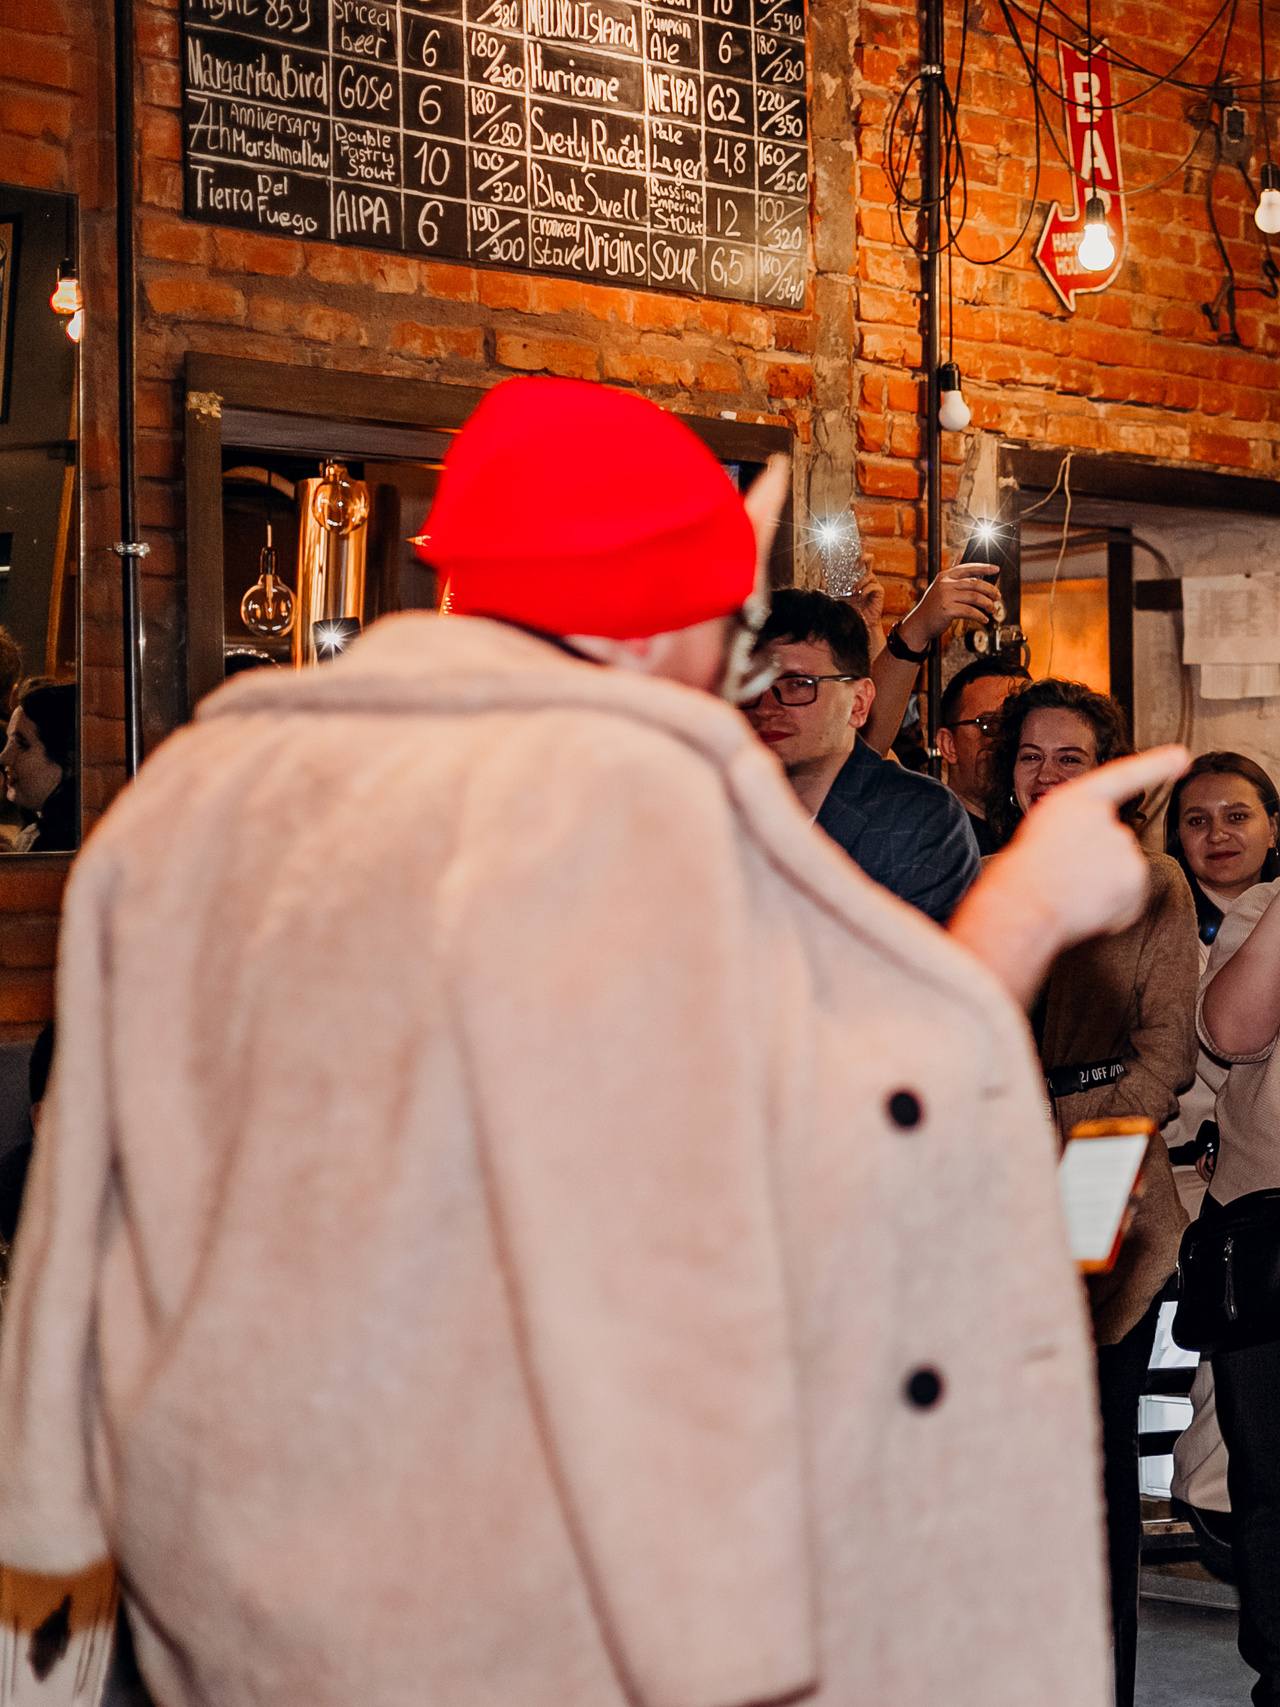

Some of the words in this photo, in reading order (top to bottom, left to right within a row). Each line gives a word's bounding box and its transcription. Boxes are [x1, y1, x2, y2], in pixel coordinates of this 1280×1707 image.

[341, 27, 387, 59] beer
[645, 9, 692, 39] Pumpkin
[422, 29, 441, 68] 6
[650, 32, 681, 64] Ale
[718, 31, 733, 64] 6
[187, 36, 286, 101] Margarita
[281, 54, 328, 105] Bird
[418, 84, 442, 125] 6
[648, 70, 698, 117] NEIPA
[187, 95, 231, 153] 7th
[334, 122, 391, 148] Double
[652, 121, 684, 146] Pale
[232, 128, 330, 169] Marshmallow
[340, 140, 395, 168] Pastry
[413, 141, 450, 187] 10
[652, 144, 703, 186] Lager
[713, 137, 747, 178] 4,8
[189, 164, 254, 212] Tierra
[257, 174, 288, 196] Del
[347, 159, 396, 182] Stout
[651, 177, 701, 201] Russian
[531, 161, 585, 212] Black
[584, 172, 640, 221] Swell
[257, 195, 318, 235] Fuego
[335, 189, 391, 235] AIPA
[417, 200, 444, 247] 6
[717, 197, 742, 237] 12
[533, 236, 585, 271] Stave
[584, 224, 647, 277] Origins
[1051, 231, 1086, 253] HAPP
[710, 246, 746, 289] 6,5
[1055, 255, 1093, 276] HOU
[1091, 1066, 1109, 1081] OFF
